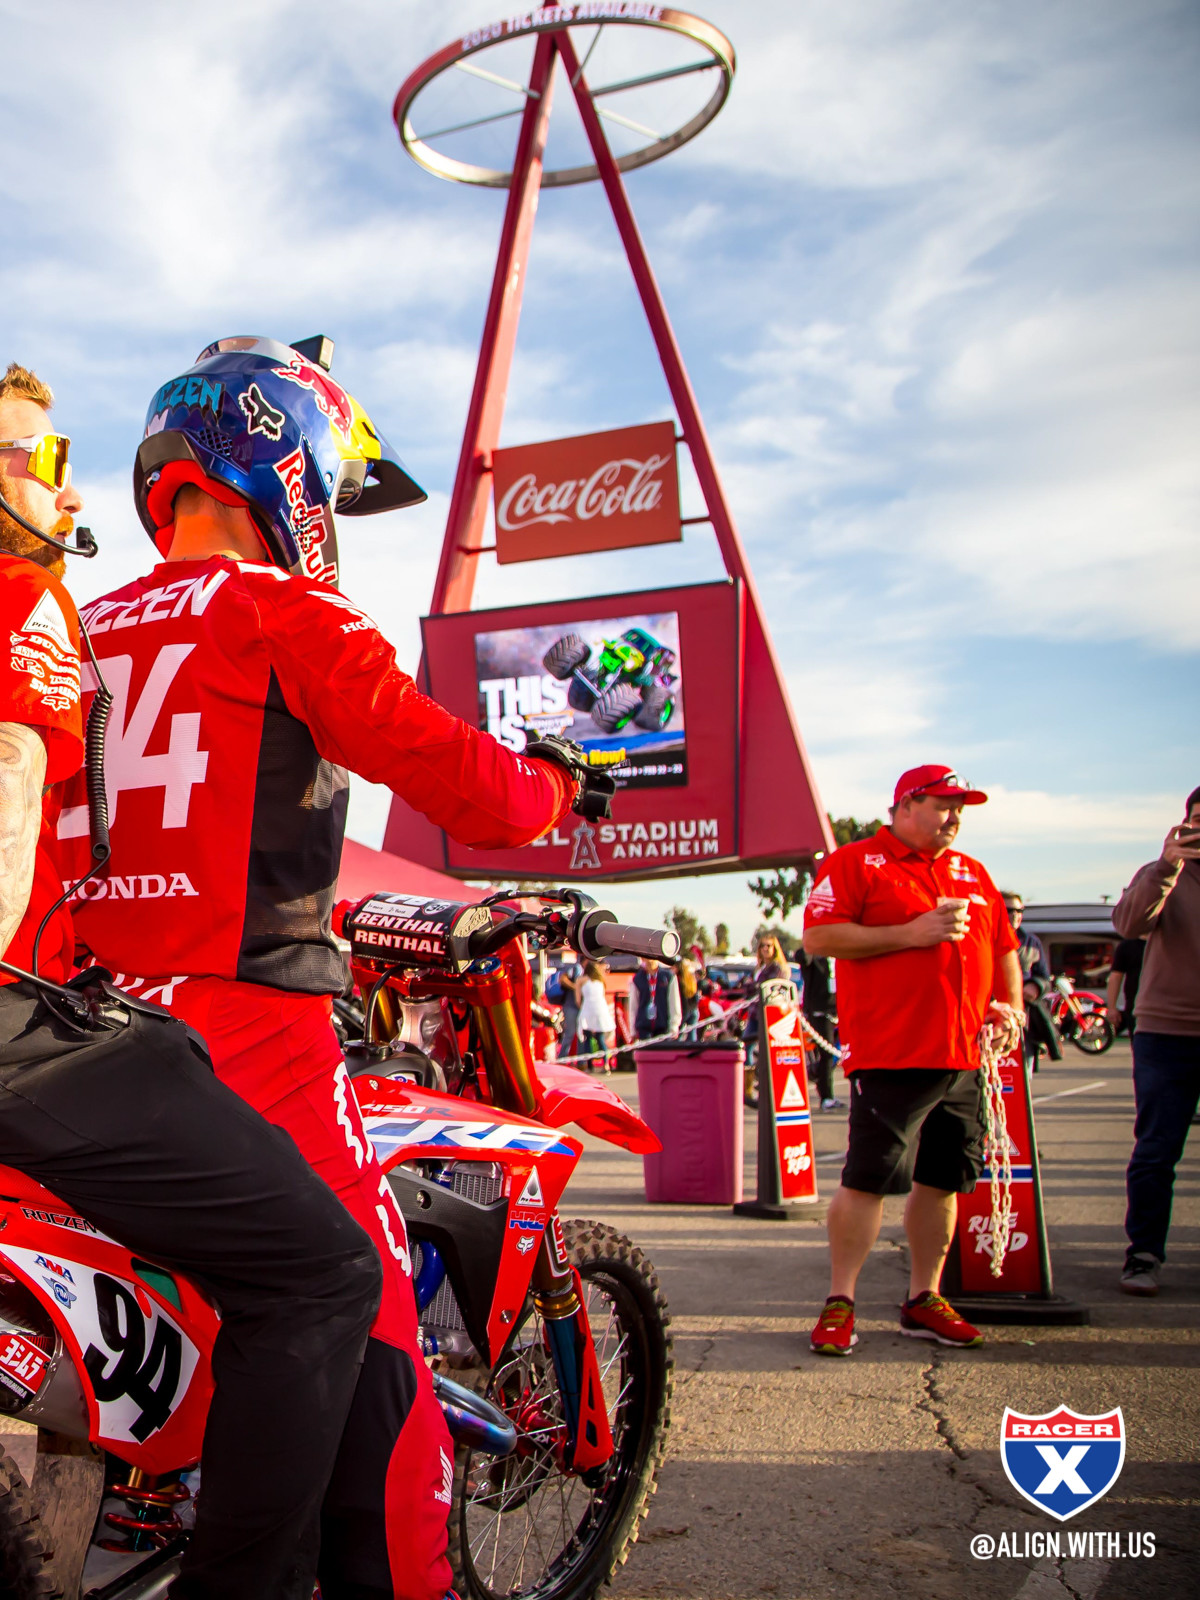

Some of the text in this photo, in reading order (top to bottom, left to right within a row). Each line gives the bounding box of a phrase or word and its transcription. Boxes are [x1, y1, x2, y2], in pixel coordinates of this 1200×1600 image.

[462, 2, 663, 50] 2020 TICKETS AVAILABLE
[156, 376, 222, 414] CZEN
[272, 445, 324, 526] Red
[499, 454, 671, 531] Coca-Cola
[29, 634, 81, 668] DUNLO
[479, 674, 570, 718] THIS
[601, 819, 719, 844] STADIUM
[612, 839, 719, 860] ANAHEIM
[353, 912, 445, 935] RENTHAL
[355, 929, 446, 954] RENTHAL
[361, 1103, 454, 1118] 450R
[362, 1117, 568, 1150] CRF
[21, 1207, 98, 1233] ROCZEN
[509, 1211, 546, 1231] HRC
[974, 1232, 1029, 1259] RD
[34, 1253, 76, 1287] AMA
[82, 1272, 182, 1446] 94
